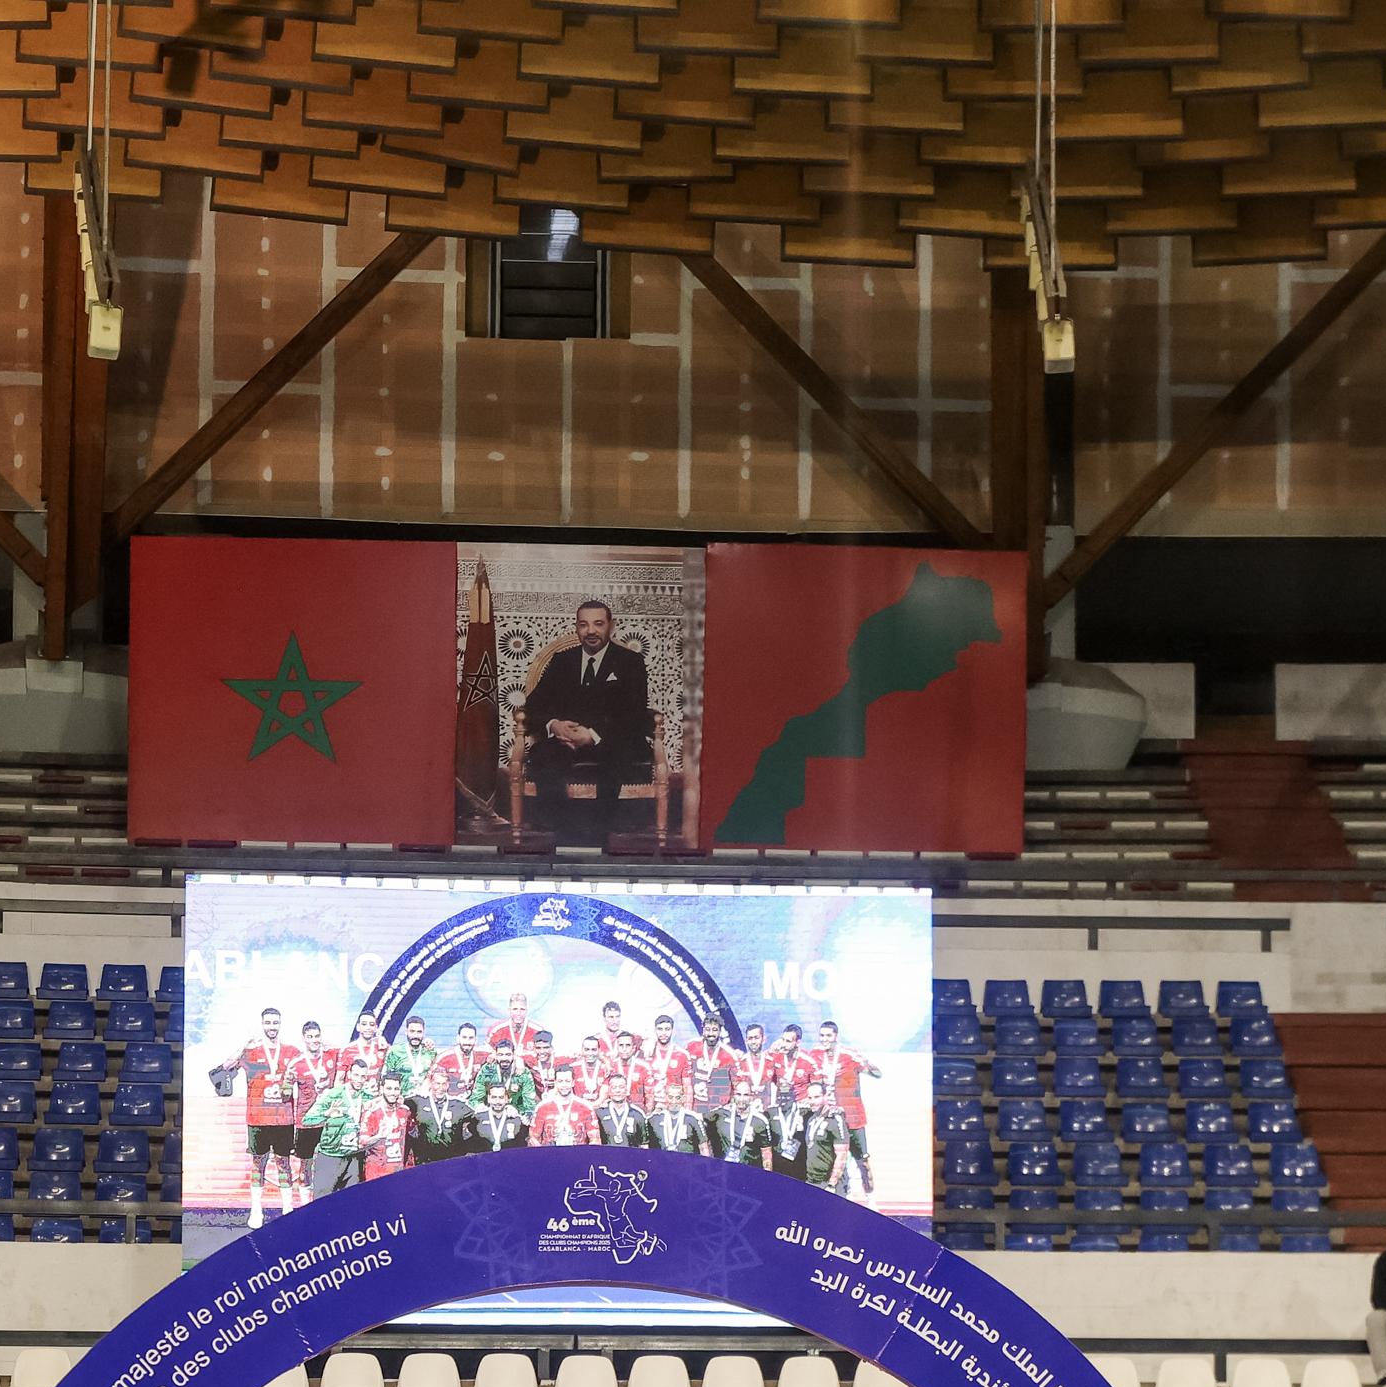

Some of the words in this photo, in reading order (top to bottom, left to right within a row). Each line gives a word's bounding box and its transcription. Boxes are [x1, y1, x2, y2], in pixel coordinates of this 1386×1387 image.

[546, 1217, 569, 1232] 46
[571, 1216, 595, 1227] ème
[775, 1220, 810, 1247] الله
[813, 1237, 865, 1264] نصره
[187, 1307, 213, 1329] le
[214, 1281, 246, 1314] roi
[246, 1221, 382, 1294] mohammed
[386, 1213, 407, 1236] vi
[810, 1267, 849, 1293] اليد
[865, 1259, 953, 1309] السادس
[171, 1349, 211, 1387] des
[212, 1308, 269, 1354] clubs
[271, 1249, 393, 1314] champions
[851, 1283, 896, 1316] لكرة
[896, 1307, 964, 1361] البطلة
[949, 1302, 1001, 1344] محمد
